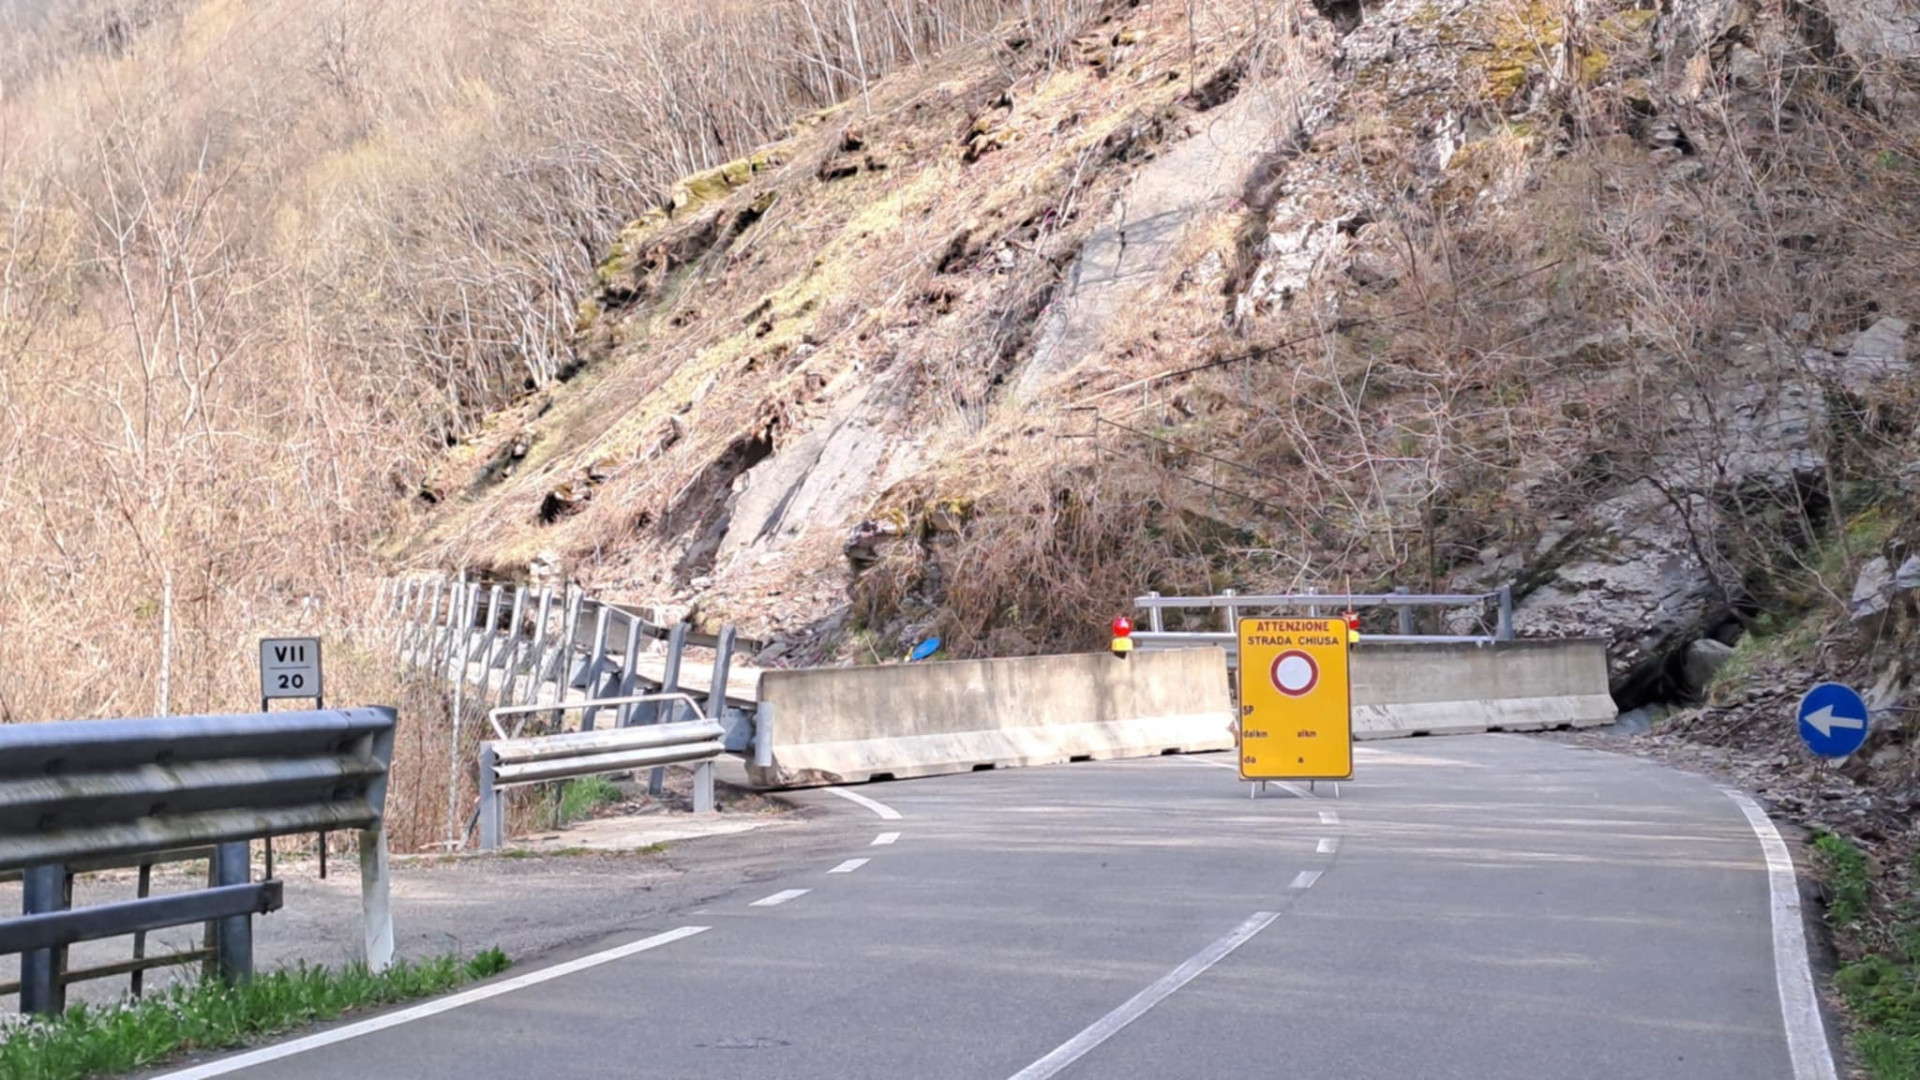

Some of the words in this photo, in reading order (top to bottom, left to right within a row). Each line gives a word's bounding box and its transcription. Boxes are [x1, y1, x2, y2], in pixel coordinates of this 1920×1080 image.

[1256, 621, 1330, 632] ATTENZIONE
[1248, 636, 1292, 646] STRADA
[1298, 636, 1339, 646] CHIUSA
[274, 645, 304, 662] VII
[278, 674, 304, 689] 20
[1243, 705, 1254, 716] SP
